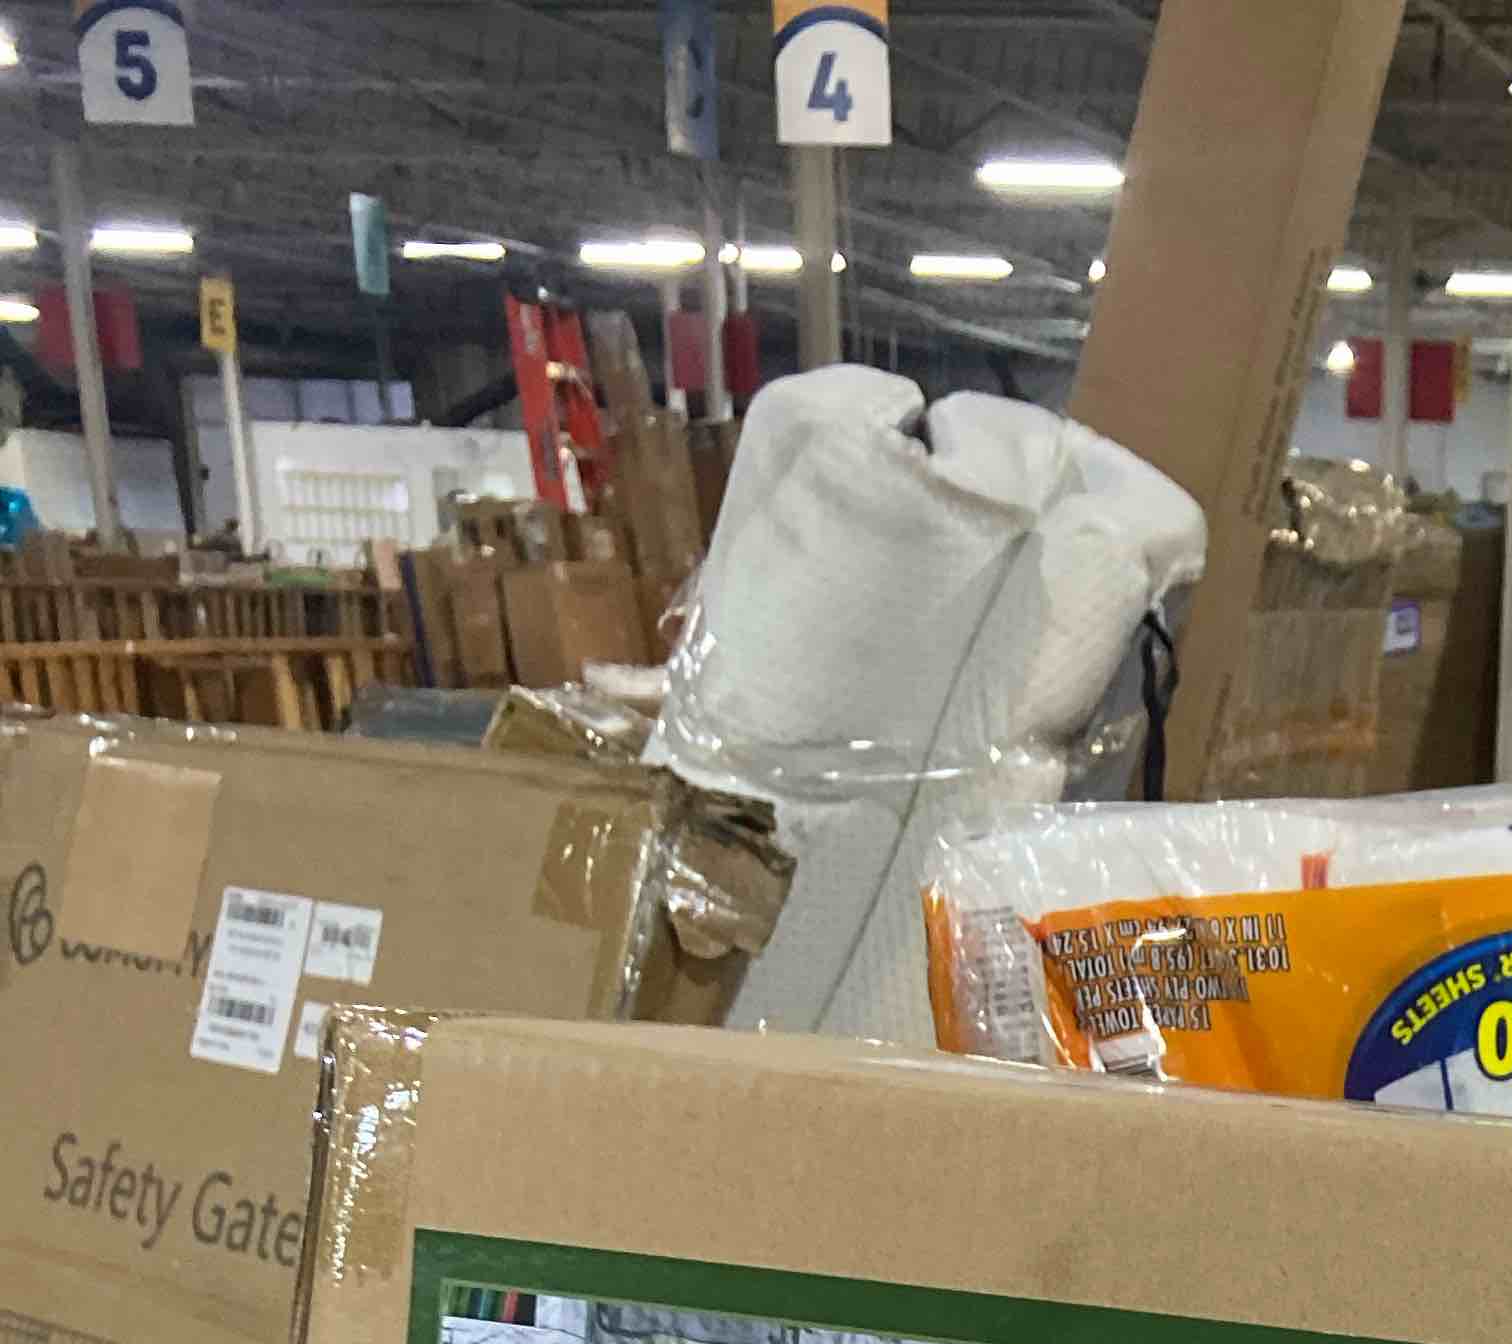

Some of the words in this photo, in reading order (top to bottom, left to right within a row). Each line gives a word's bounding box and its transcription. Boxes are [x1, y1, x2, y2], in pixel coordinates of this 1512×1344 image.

[114, 30, 159, 102] 5
[807, 51, 853, 122] 4
[1067, 954, 1114, 981] TOTAL
[1143, 1004, 1186, 1029] PAPE
[1391, 963, 1486, 1045] SHEETS
[44, 1131, 182, 1249] Safety
[192, 1170, 304, 1267] Gate
